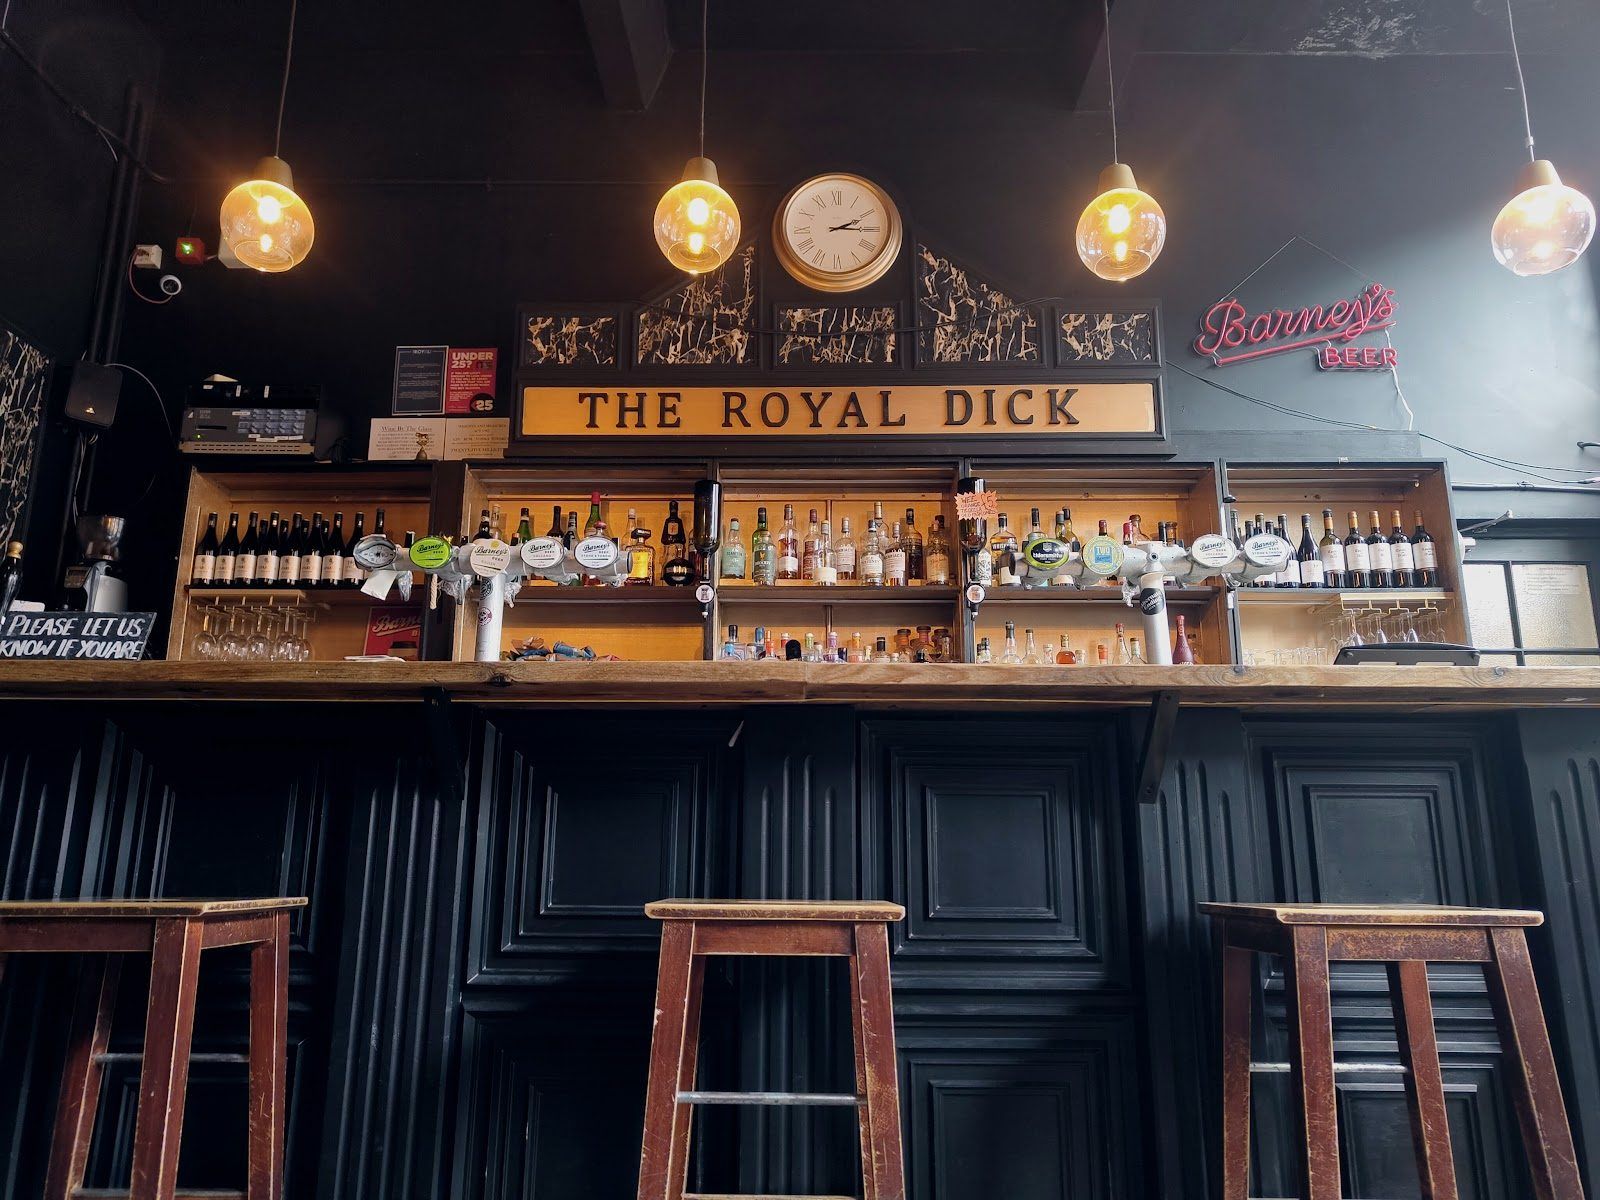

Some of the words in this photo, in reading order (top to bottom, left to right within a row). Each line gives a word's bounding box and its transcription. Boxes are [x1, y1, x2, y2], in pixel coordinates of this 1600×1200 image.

[1195, 283, 1399, 355] Barney's
[451, 360, 473, 369] 25?
[452, 352, 494, 360] UNDER
[1321, 347, 1398, 367] BEER
[476, 400, 494, 411] 25
[578, 392, 682, 428] THE
[721, 391, 906, 428] ROYAL
[944, 388, 1080, 426] DICK
[7, 615, 78, 636] PLEASE
[81, 618, 118, 636] LET
[117, 618, 146, 637] US
[0, 639, 57, 657] KNOW
[56, 639, 79, 657] IF
